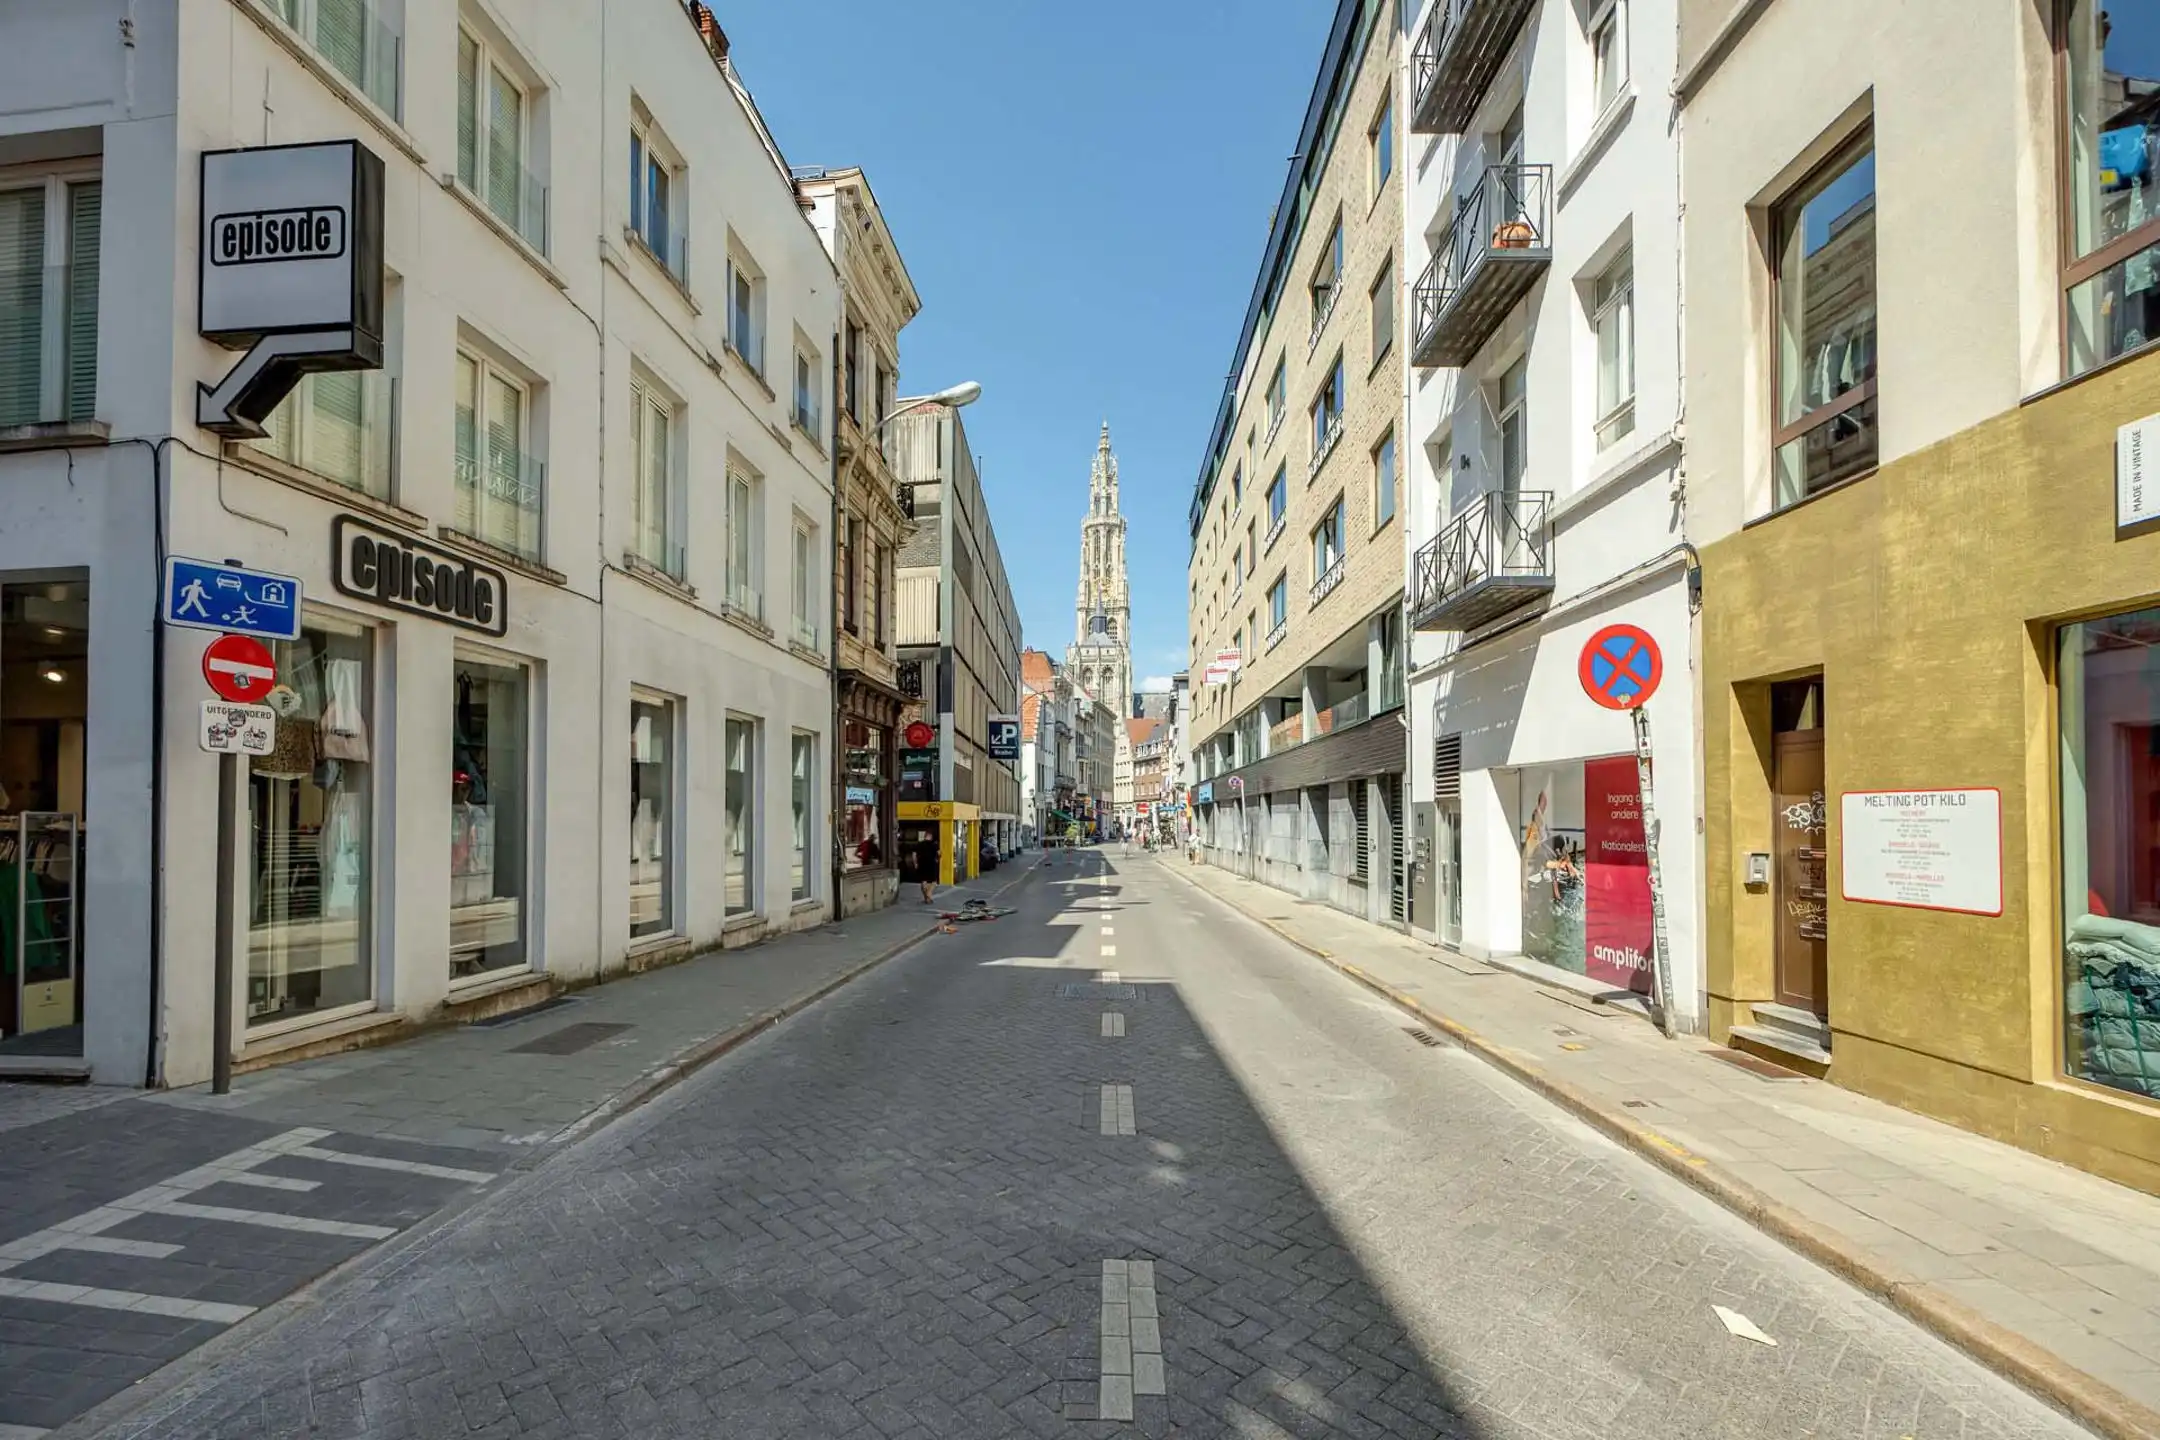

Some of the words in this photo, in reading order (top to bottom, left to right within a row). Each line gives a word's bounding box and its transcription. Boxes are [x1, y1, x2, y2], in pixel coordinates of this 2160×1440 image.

[223, 212, 331, 260] episode
[2132, 428, 2142, 469] VINTAGE
[2133, 470, 2142, 483] IN
[2133, 484, 2142, 512] MADE
[352, 535, 493, 624] episode
[1001, 723, 1018, 745] P
[1608, 793, 1633, 806] Ingang
[1864, 795, 1911, 808] MELTING
[1913, 794, 1936, 807] POT
[1940, 793, 1966, 806] KILO
[1611, 809, 1639, 819] andere
